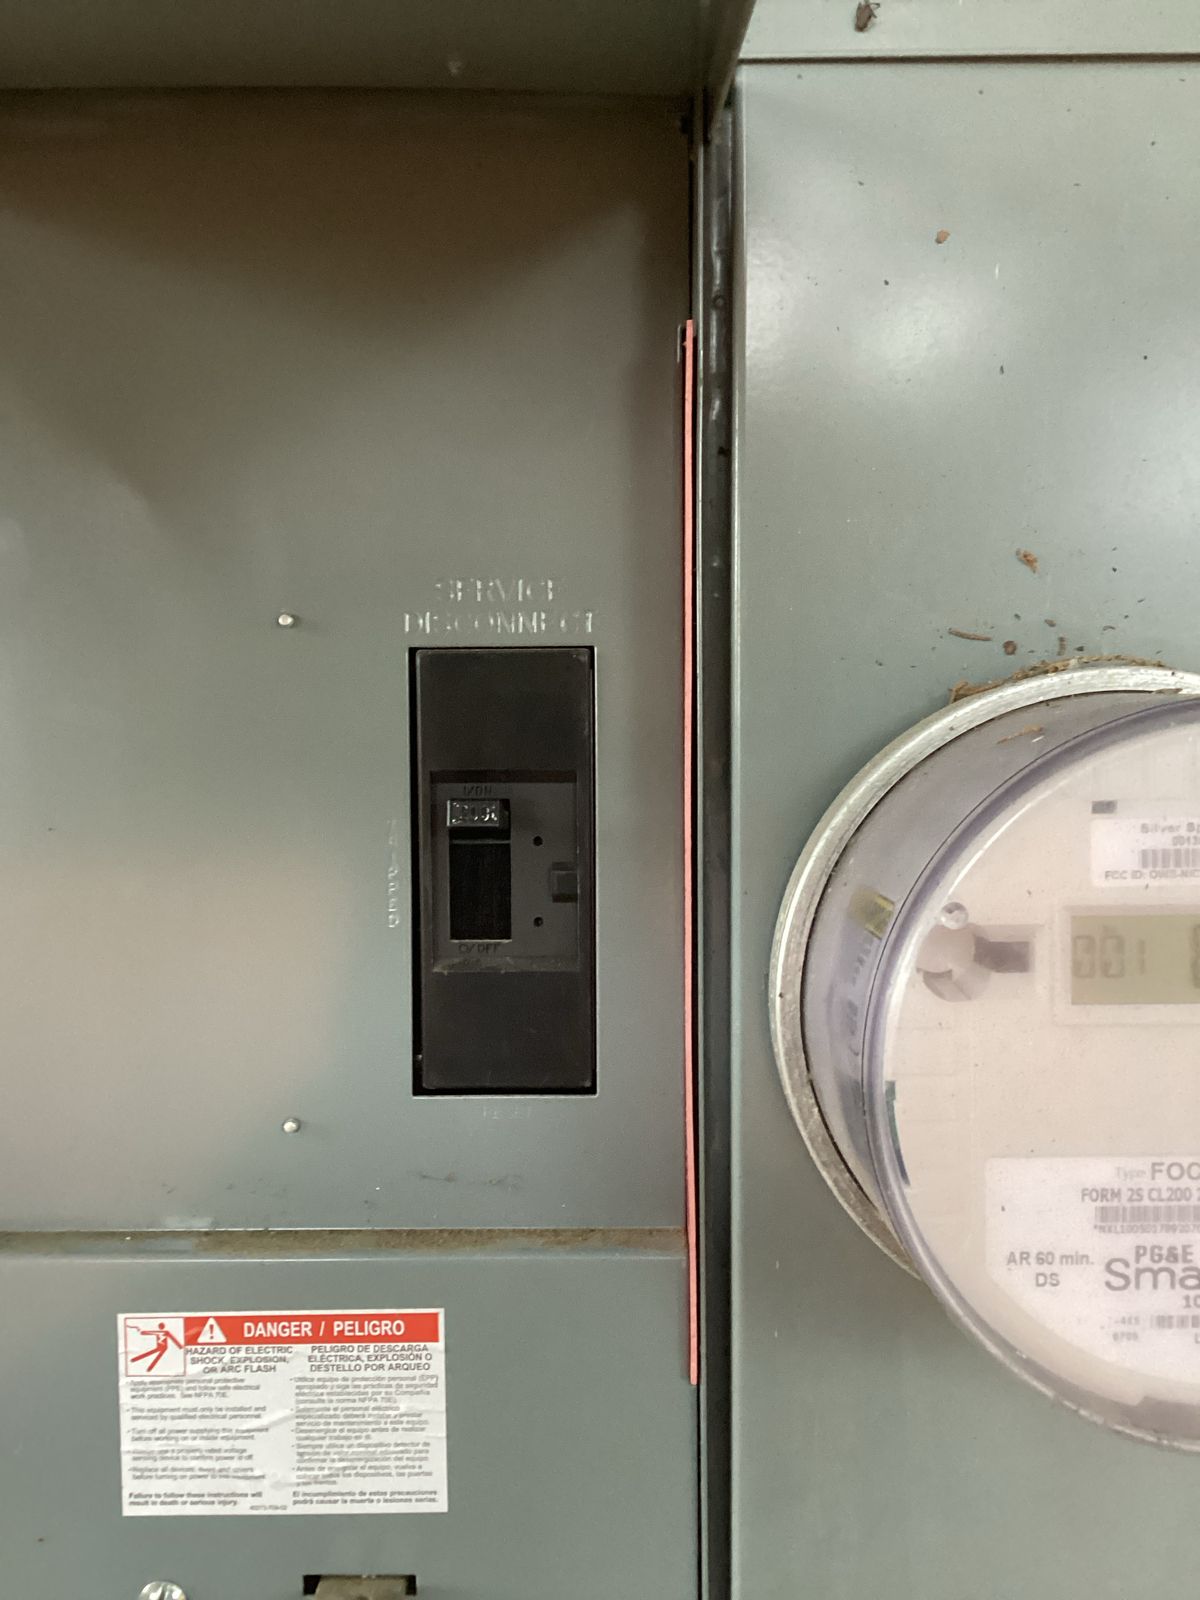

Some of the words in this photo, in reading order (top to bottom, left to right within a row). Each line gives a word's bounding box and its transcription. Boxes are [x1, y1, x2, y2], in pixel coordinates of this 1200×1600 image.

[1104, 869, 1128, 880] FCC
[1080, 1187, 1122, 1203] FORM
[1126, 1187, 1144, 1202] 2S
[1147, 1187, 1192, 1202] CL200
[1007, 1251, 1031, 1265] AR
[1035, 1251, 1055, 1265] 60
[1059, 1251, 1094, 1265] min.
[1134, 1244, 1194, 1264] PG&E
[1035, 1272, 1061, 1287] DS
[243, 1321, 312, 1338] DANGER
[333, 1319, 406, 1337] PELIGRO
[185, 1346, 227, 1356] HAZARD
[229, 1346, 242, 1355] OF
[245, 1345, 294, 1355] ELECTRIC
[311, 1344, 355, 1354] PELIGRO
[357, 1344, 371, 1353] DE
[373, 1343, 429, 1353] DESCARGA
[425, 1352, 433, 1361] O
[203, 1366, 220, 1375] OR
[221, 1365, 242, 1374] ARC
[244, 1364, 277, 1374] FLASH
[310, 1363, 362, 1373] DESTELLO
[364, 1362, 386, 1372] POR
[388, 1361, 431, 1372] ARQUEO
